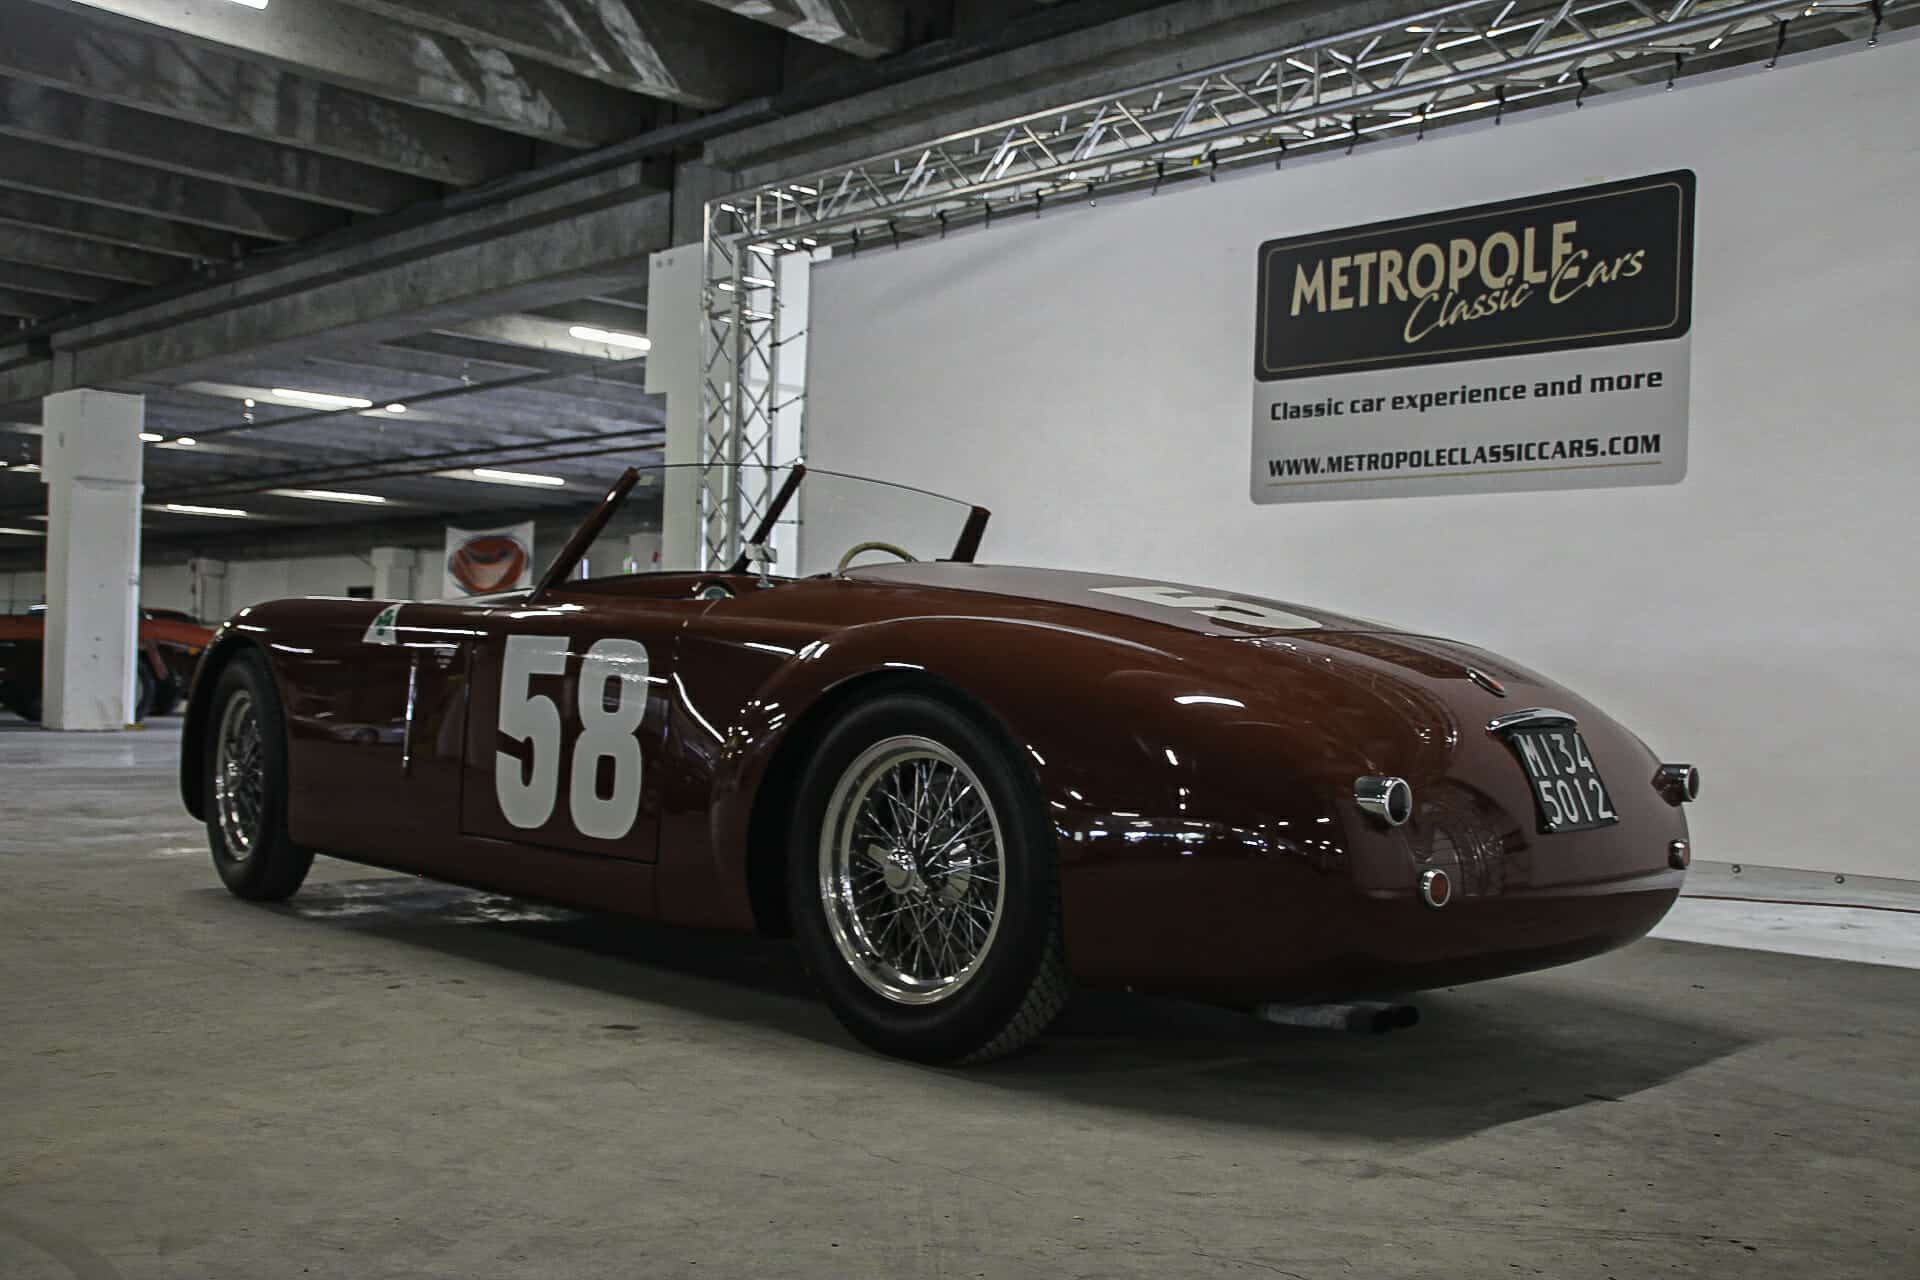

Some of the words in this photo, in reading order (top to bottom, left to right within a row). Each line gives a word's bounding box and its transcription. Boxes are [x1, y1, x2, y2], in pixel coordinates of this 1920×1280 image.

[1290, 220, 1579, 317] METROPOLE
[1404, 275, 1533, 343] Classic
[1549, 247, 1646, 304] Cars
[1270, 397, 1344, 421] Classic
[1349, 396, 1386, 414] car
[1391, 383, 1527, 412] experience
[1533, 374, 1583, 398] and
[1589, 370, 1664, 394] more
[1268, 433, 1661, 478] WWW.METROPOLECLASSICCARS.COM
[495, 634, 650, 840] 58
[1539, 779, 1614, 824] 5012
